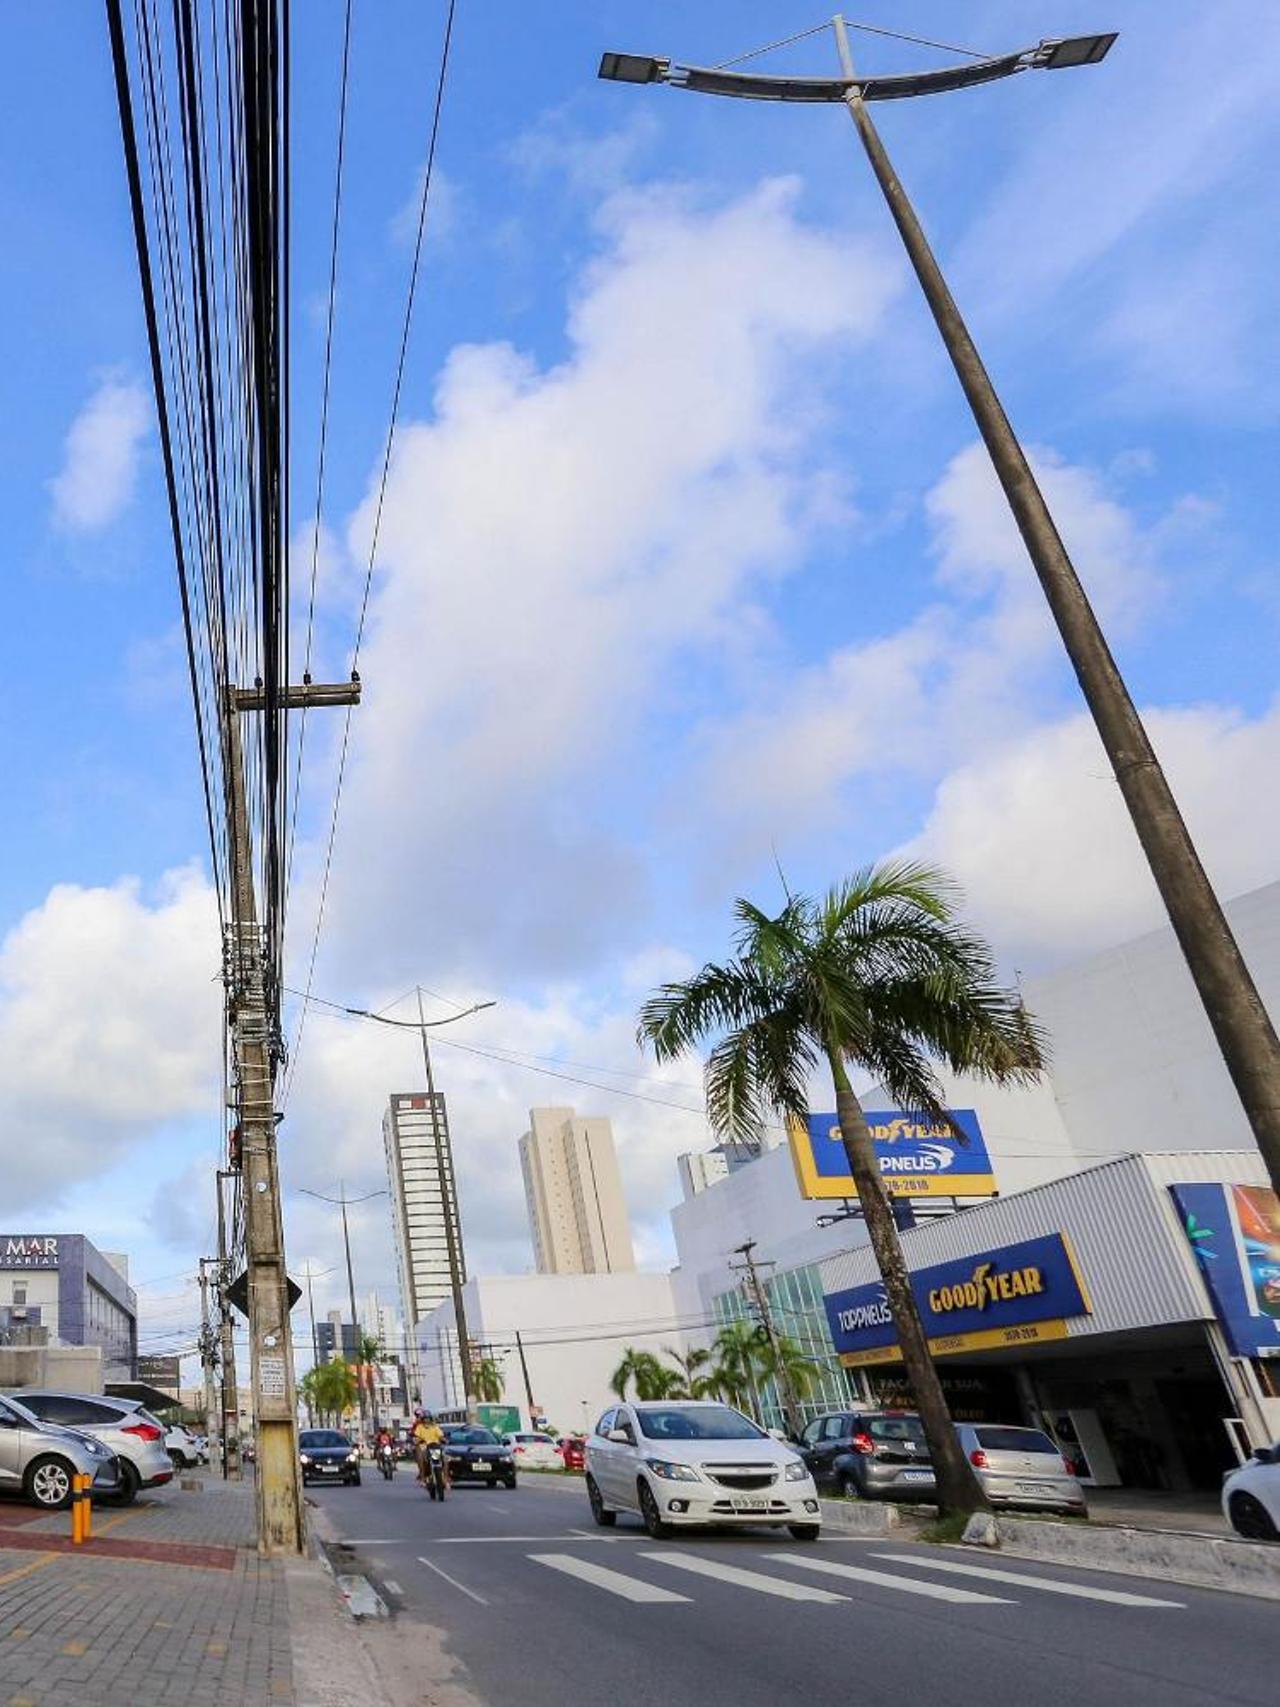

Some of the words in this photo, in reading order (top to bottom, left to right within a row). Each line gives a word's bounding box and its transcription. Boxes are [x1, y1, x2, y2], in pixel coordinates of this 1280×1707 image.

[879, 1156, 937, 1172] PNEUS
[6, 1237, 59, 1256] MAR
[928, 1263, 1044, 1314] GOODYEAR
[837, 1301, 893, 1333] TOPPNEUS
